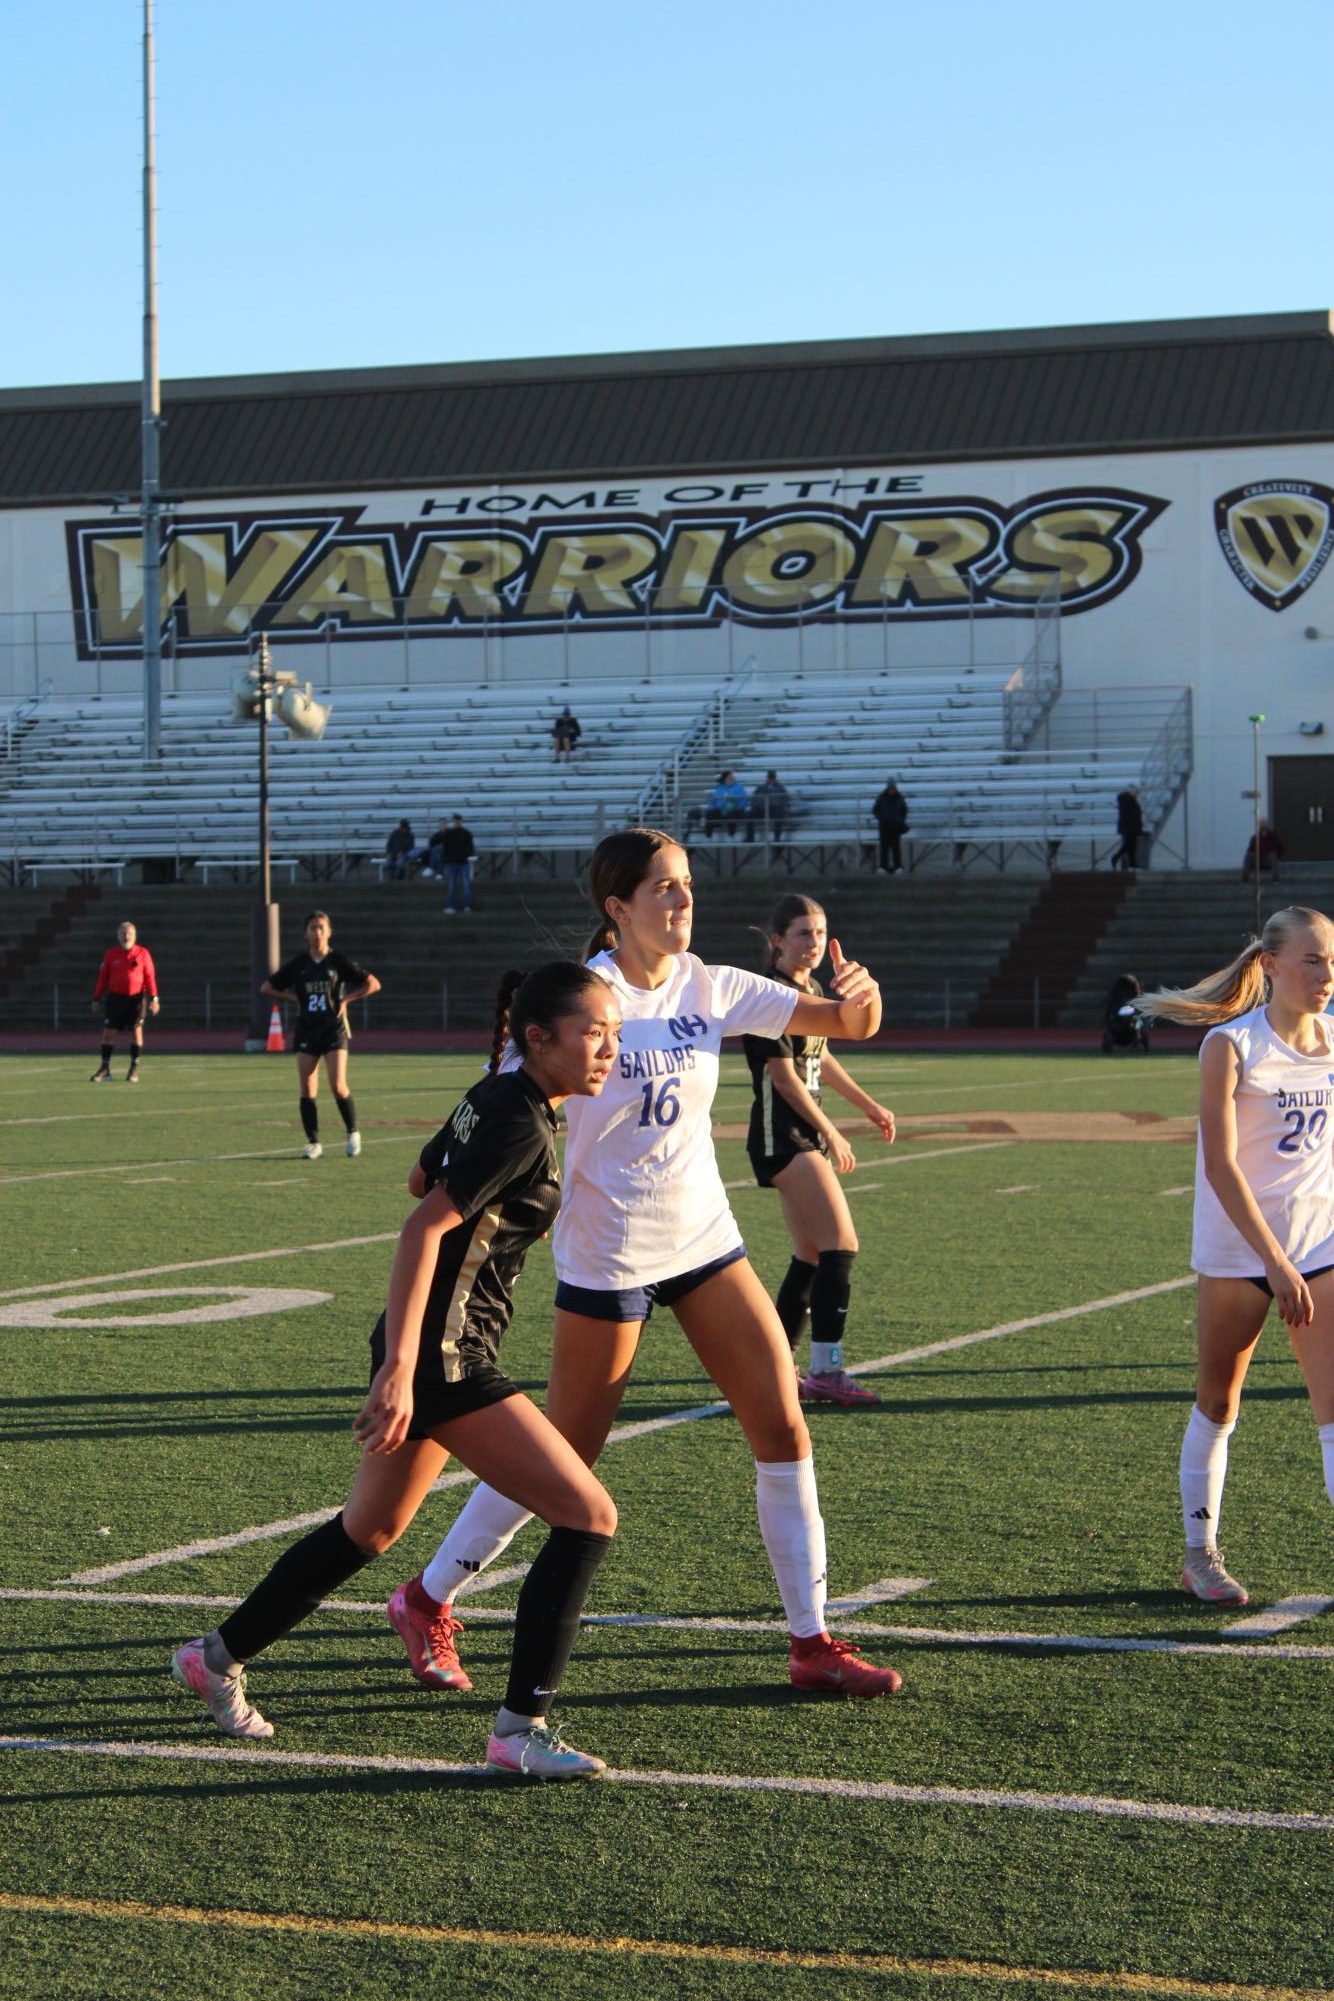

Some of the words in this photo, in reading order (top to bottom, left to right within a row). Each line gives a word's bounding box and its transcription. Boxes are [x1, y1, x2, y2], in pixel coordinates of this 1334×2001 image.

[419, 489, 641, 516] HOME
[664, 482, 769, 503] OF
[783, 475, 925, 498] THE
[1243, 483, 1313, 496] CREATIVITY
[77, 498, 1150, 653] WARRIORS
[305, 981, 329, 993] WEST
[308, 994, 327, 1012] 24
[620, 1043, 696, 1079] SAILORS
[638, 1077, 681, 1127] 16
[1278, 1089, 1333, 1108] SAILOR
[1278, 1108, 1328, 1152] 20
